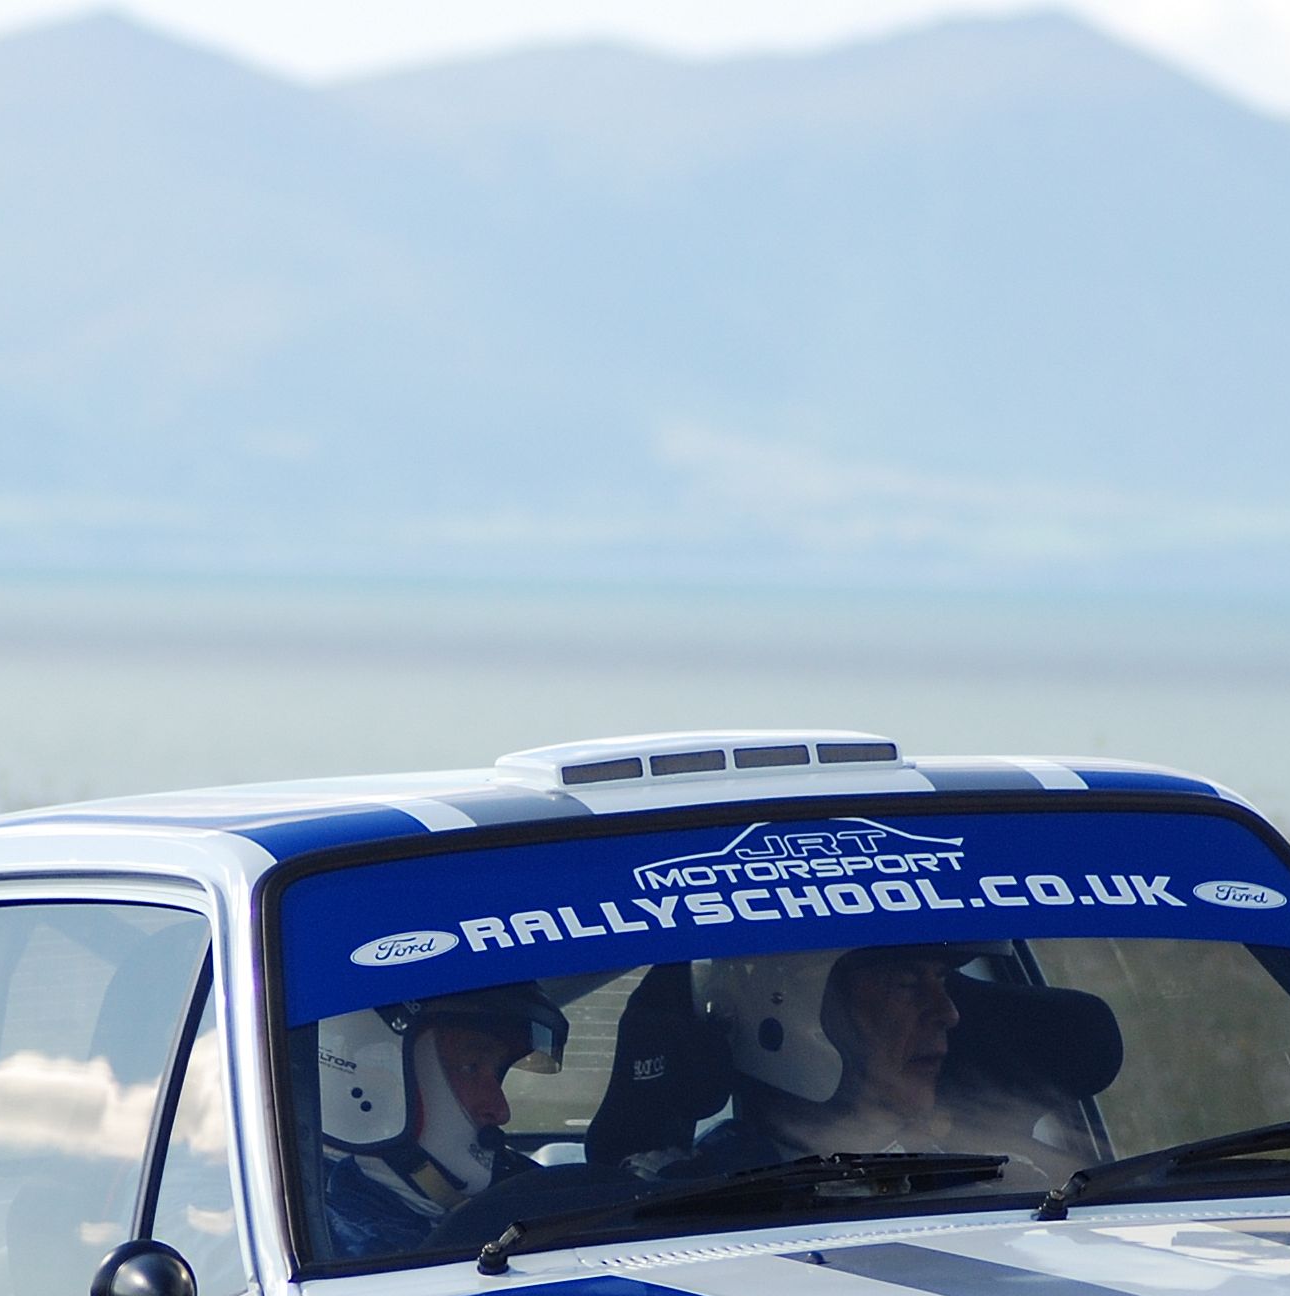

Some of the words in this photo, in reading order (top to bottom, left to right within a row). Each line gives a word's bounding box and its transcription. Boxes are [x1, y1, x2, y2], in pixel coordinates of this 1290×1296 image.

[735, 830, 887, 861] JRT
[645, 851, 965, 891] MOTORSPORT
[1214, 884, 1269, 905] Ford
[458, 874, 1188, 953] RALLYSCHOOL.CO.UK
[374, 936, 437, 961] Ford
[318, 1051, 357, 1070] LTOR
